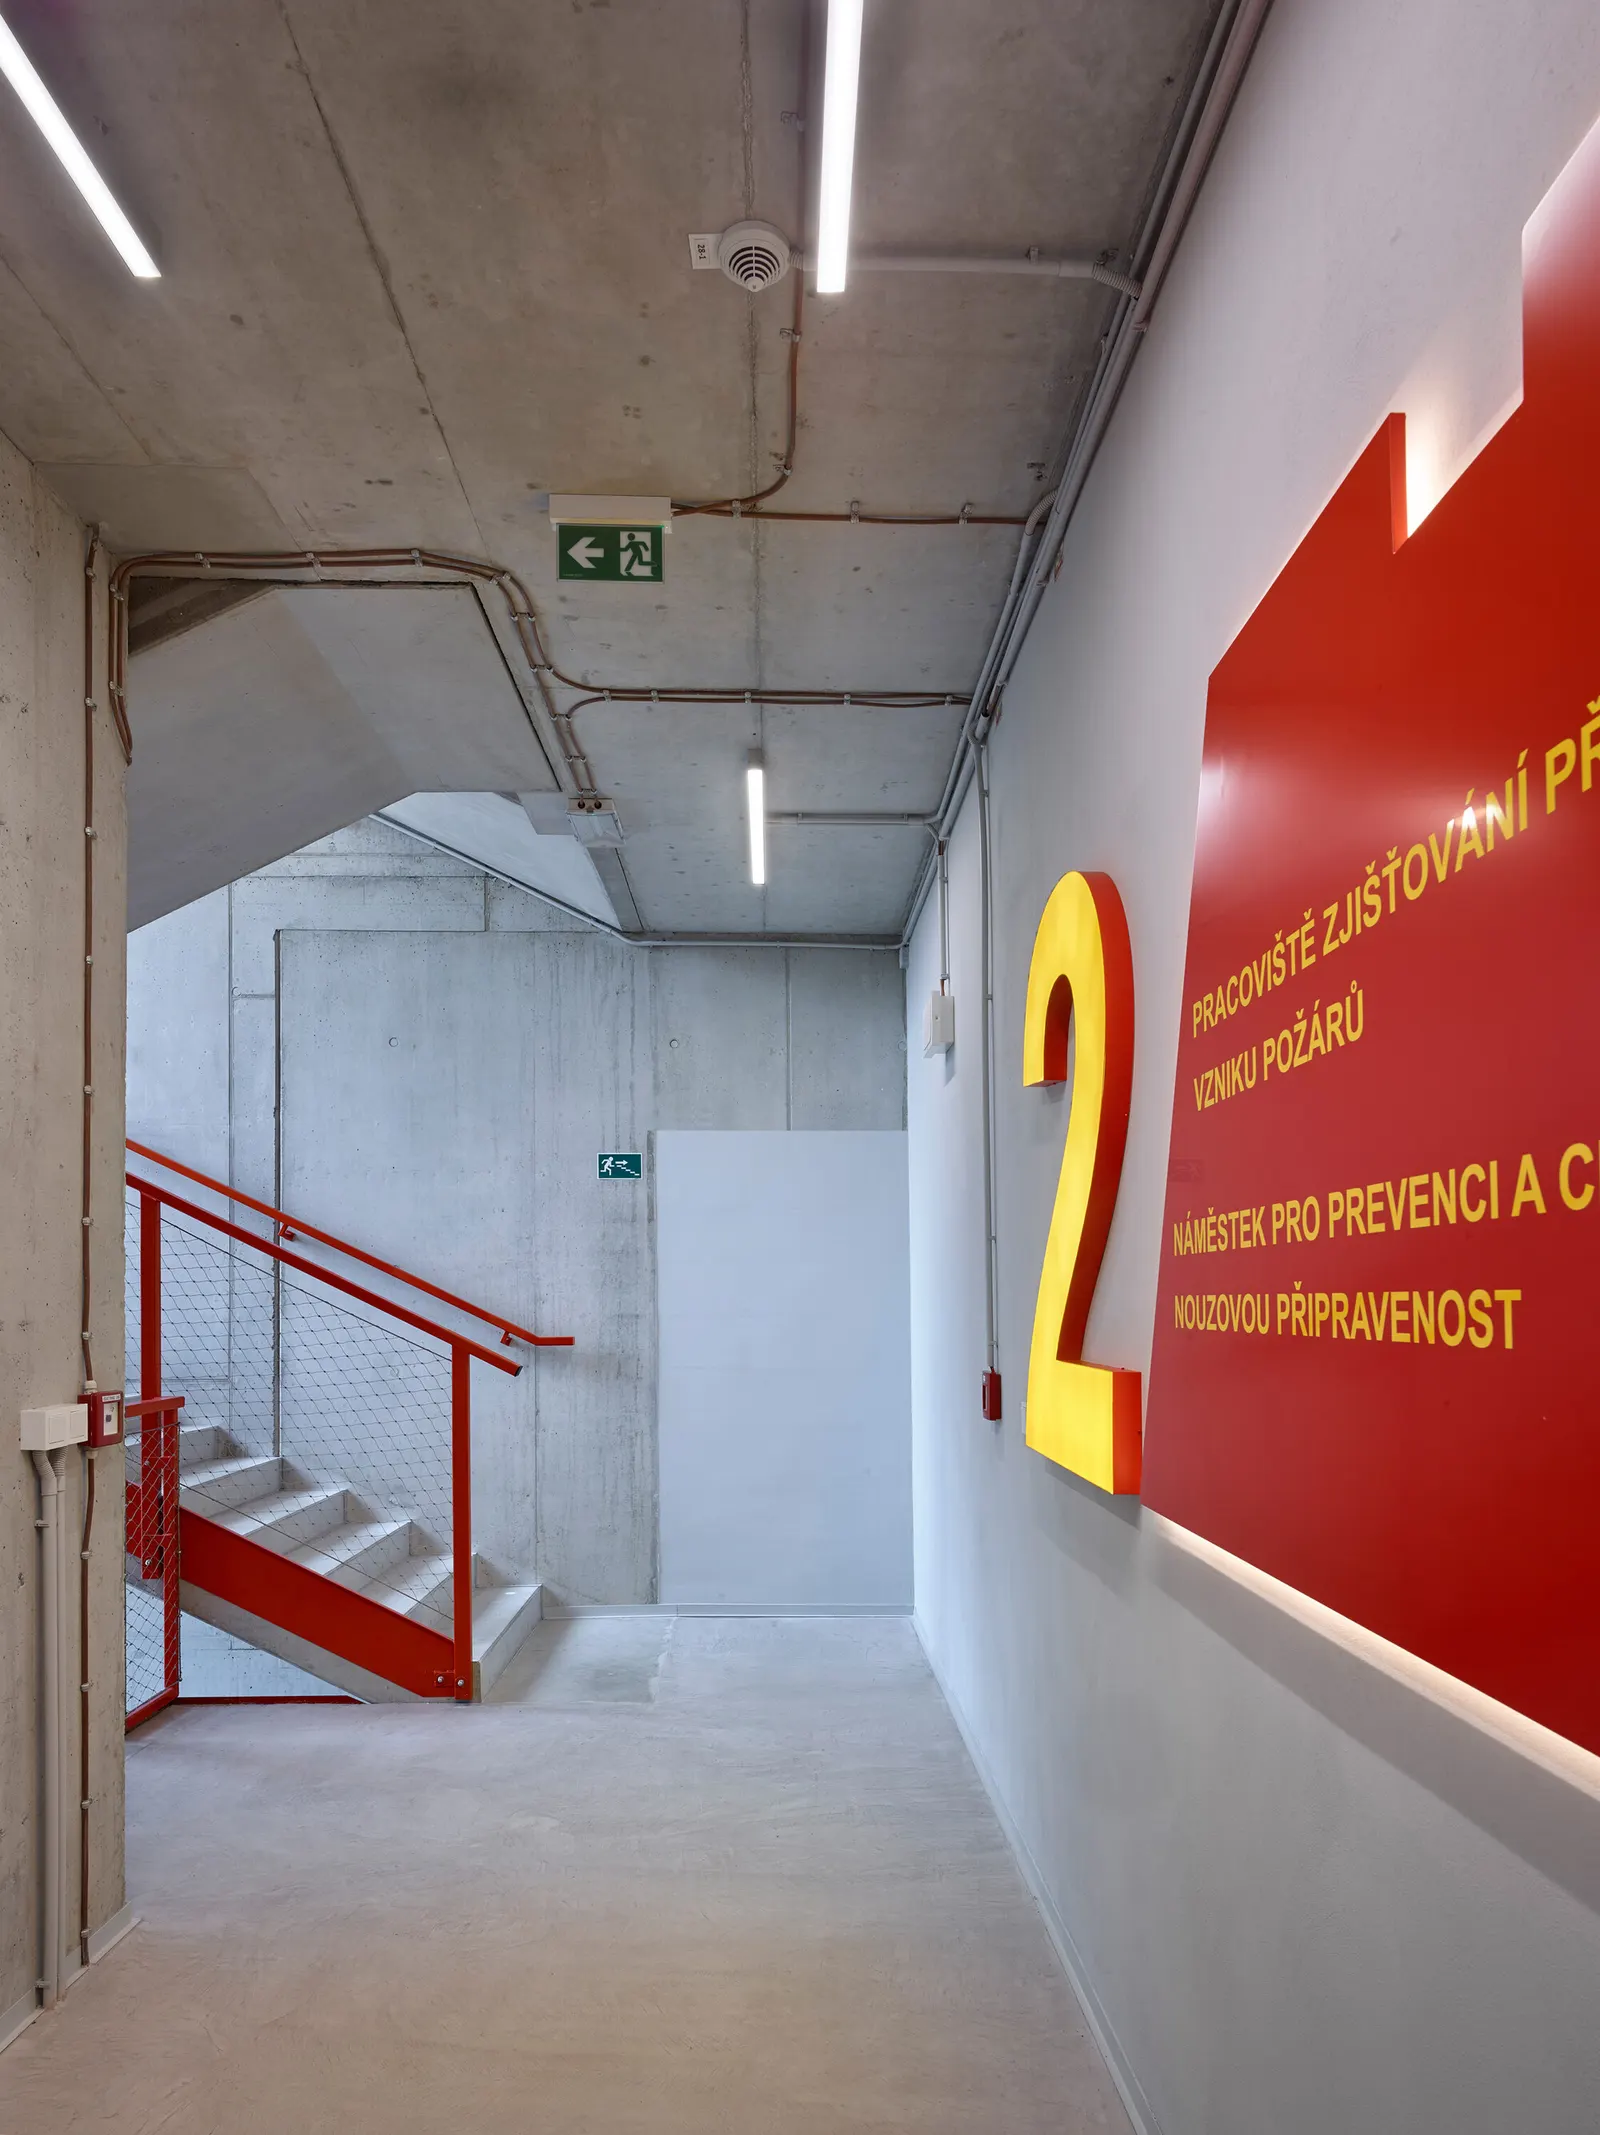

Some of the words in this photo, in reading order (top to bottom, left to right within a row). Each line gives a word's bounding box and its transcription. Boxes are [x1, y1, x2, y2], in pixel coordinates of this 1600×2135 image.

[697, 244, 707, 260] 28-1
[1192, 907, 1316, 1039] PRACOVIŠTĚ
[1322, 748, 1529, 957] ZJIŠŤOVÁNÍ
[1193, 1046, 1257, 1112] VZNIKU
[1263, 979, 1364, 1081] POŽÁRŮ
[1023, 871, 1141, 1495] 2
[1173, 1203, 1267, 1257] NÁMĚSTEK
[1271, 1195, 1321, 1245] PRO
[1328, 1160, 1499, 1239] PREVENCI
[1511, 1153, 1547, 1217] A
[1558, 1139, 1600, 1211] C
[1174, 1293, 1270, 1335] NOUZOVOU
[1276, 1280, 1522, 1350] PŘIPRAVENOST
